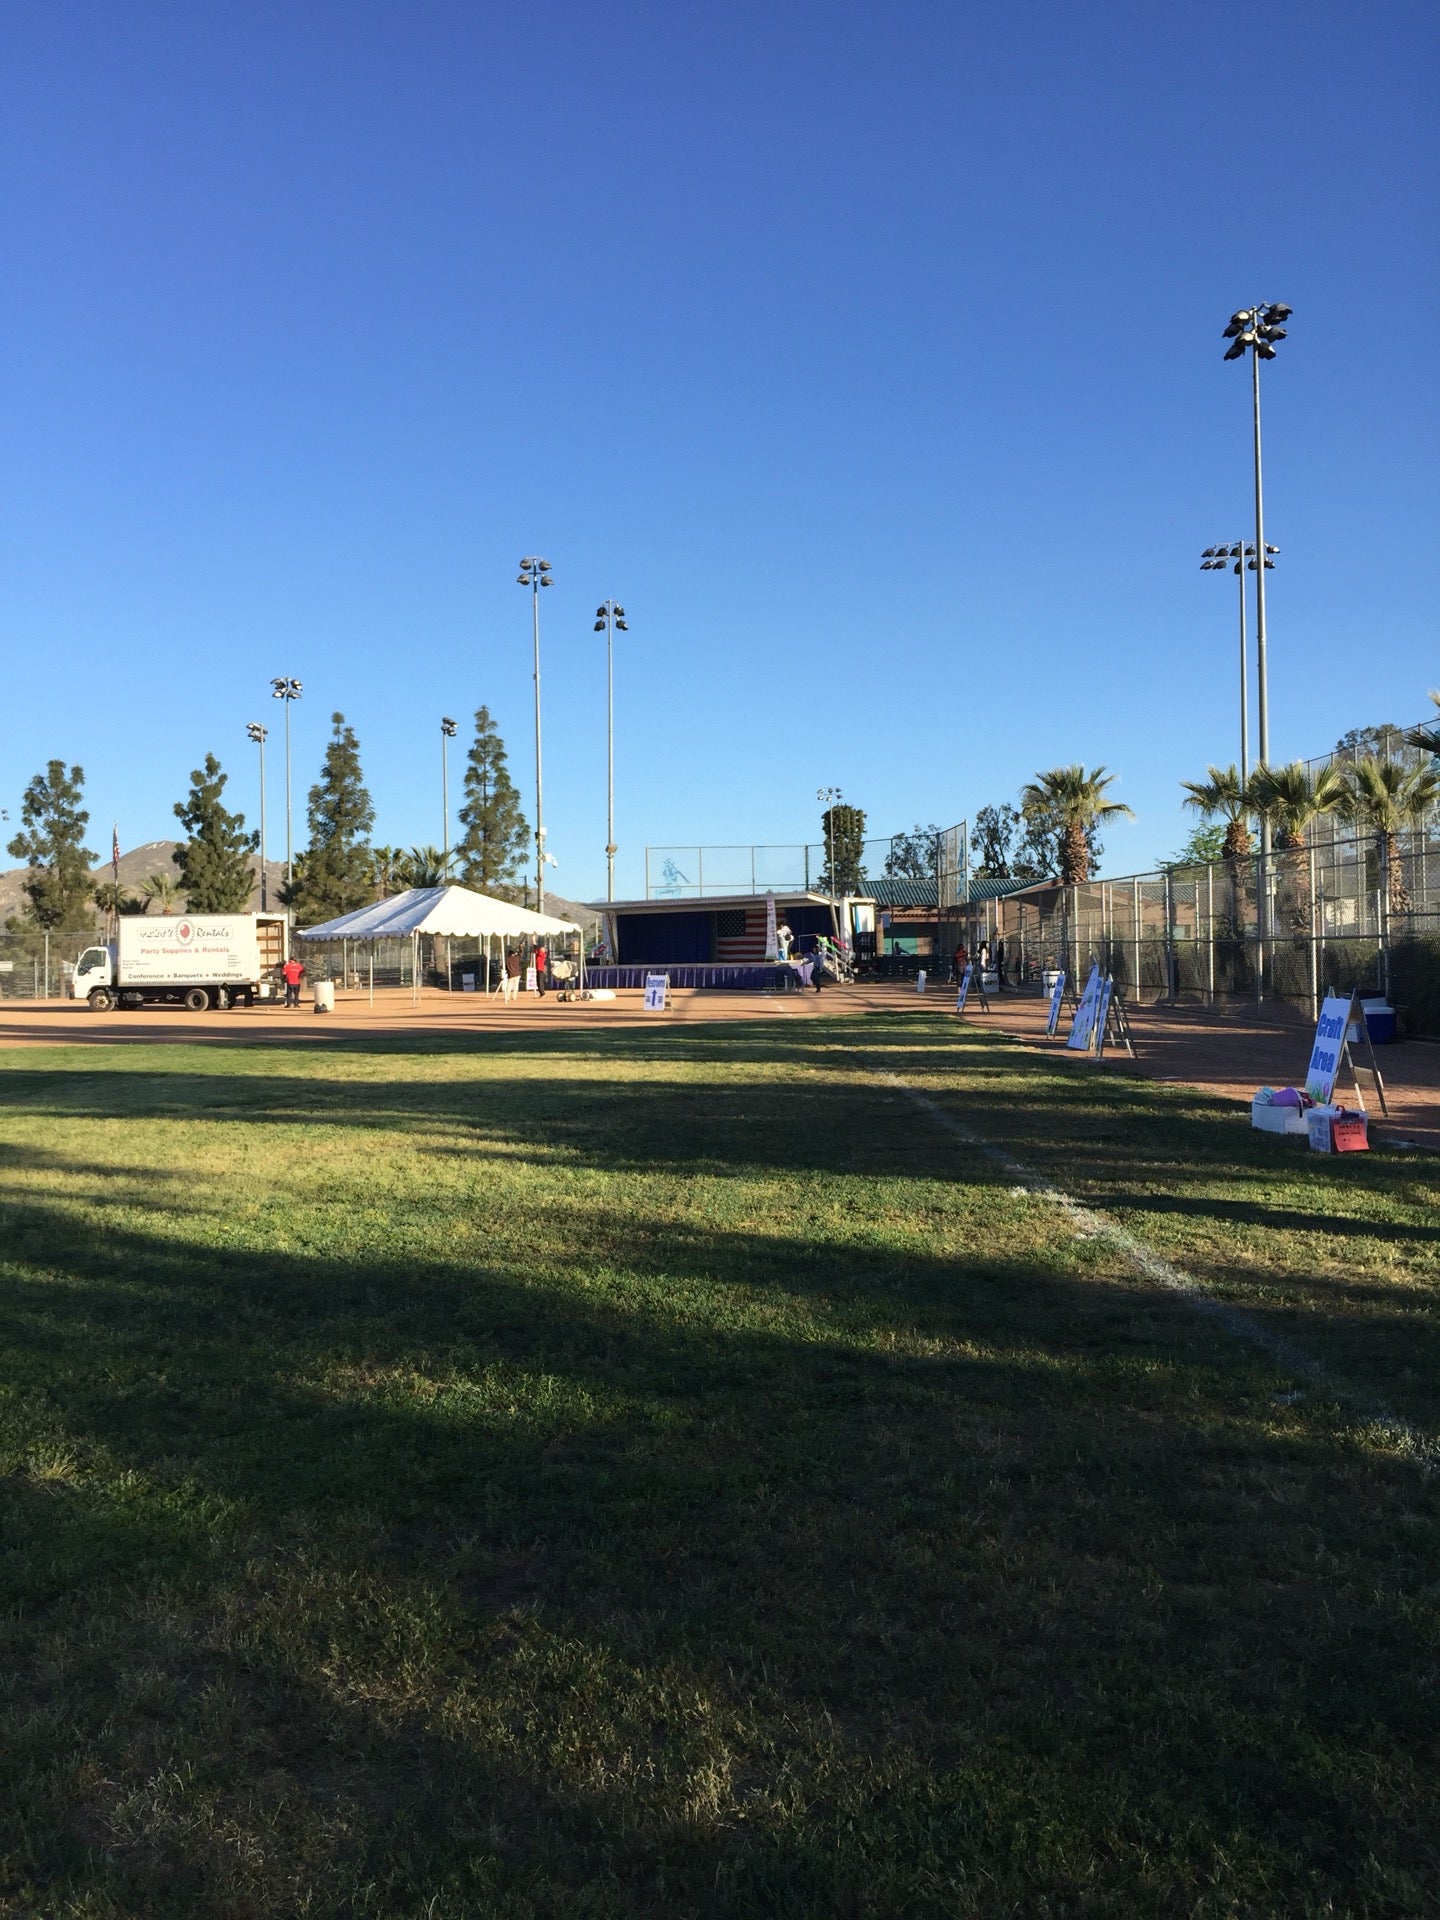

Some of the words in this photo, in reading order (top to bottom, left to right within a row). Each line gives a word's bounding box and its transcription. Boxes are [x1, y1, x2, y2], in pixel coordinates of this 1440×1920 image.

[196, 927, 229, 938] Rentals
[1318, 1014, 1343, 1039] Craft
[1311, 1047, 1334, 1072] Area
